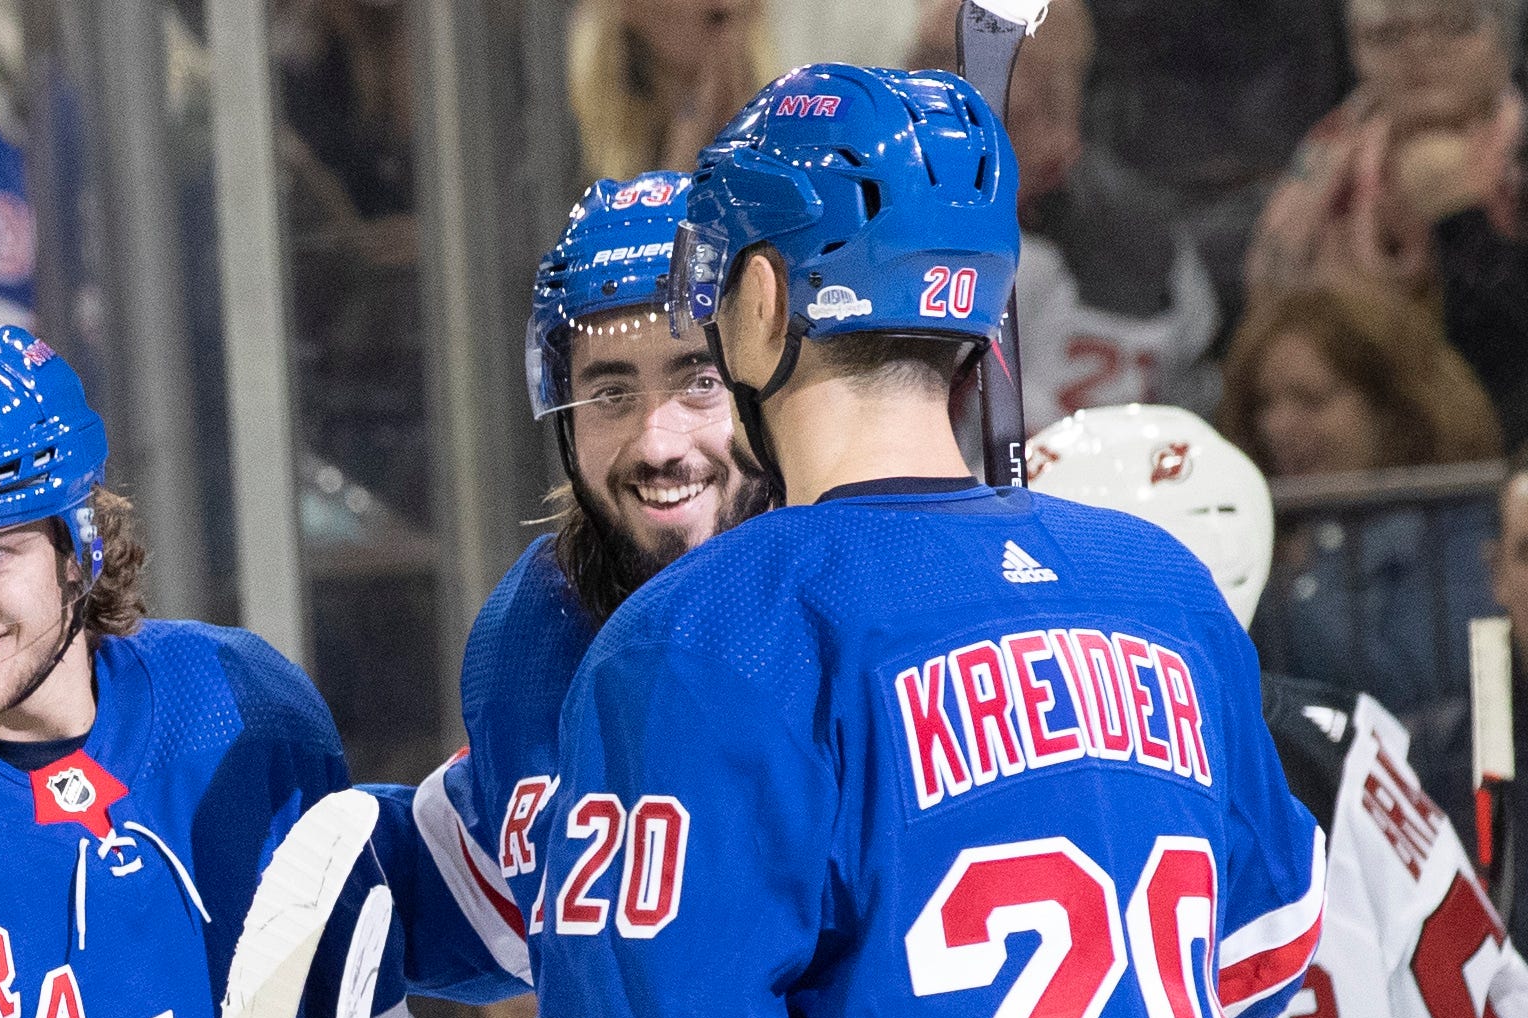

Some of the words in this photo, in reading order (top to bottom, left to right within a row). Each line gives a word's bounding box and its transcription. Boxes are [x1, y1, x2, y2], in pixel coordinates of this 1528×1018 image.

[776, 94, 842, 118] NYR
[612, 183, 674, 210] 93
[919, 266, 978, 318] 20
[1009, 442, 1023, 488] LITE
[894, 628, 1213, 811] KREIDER
[555, 792, 691, 939] 20
